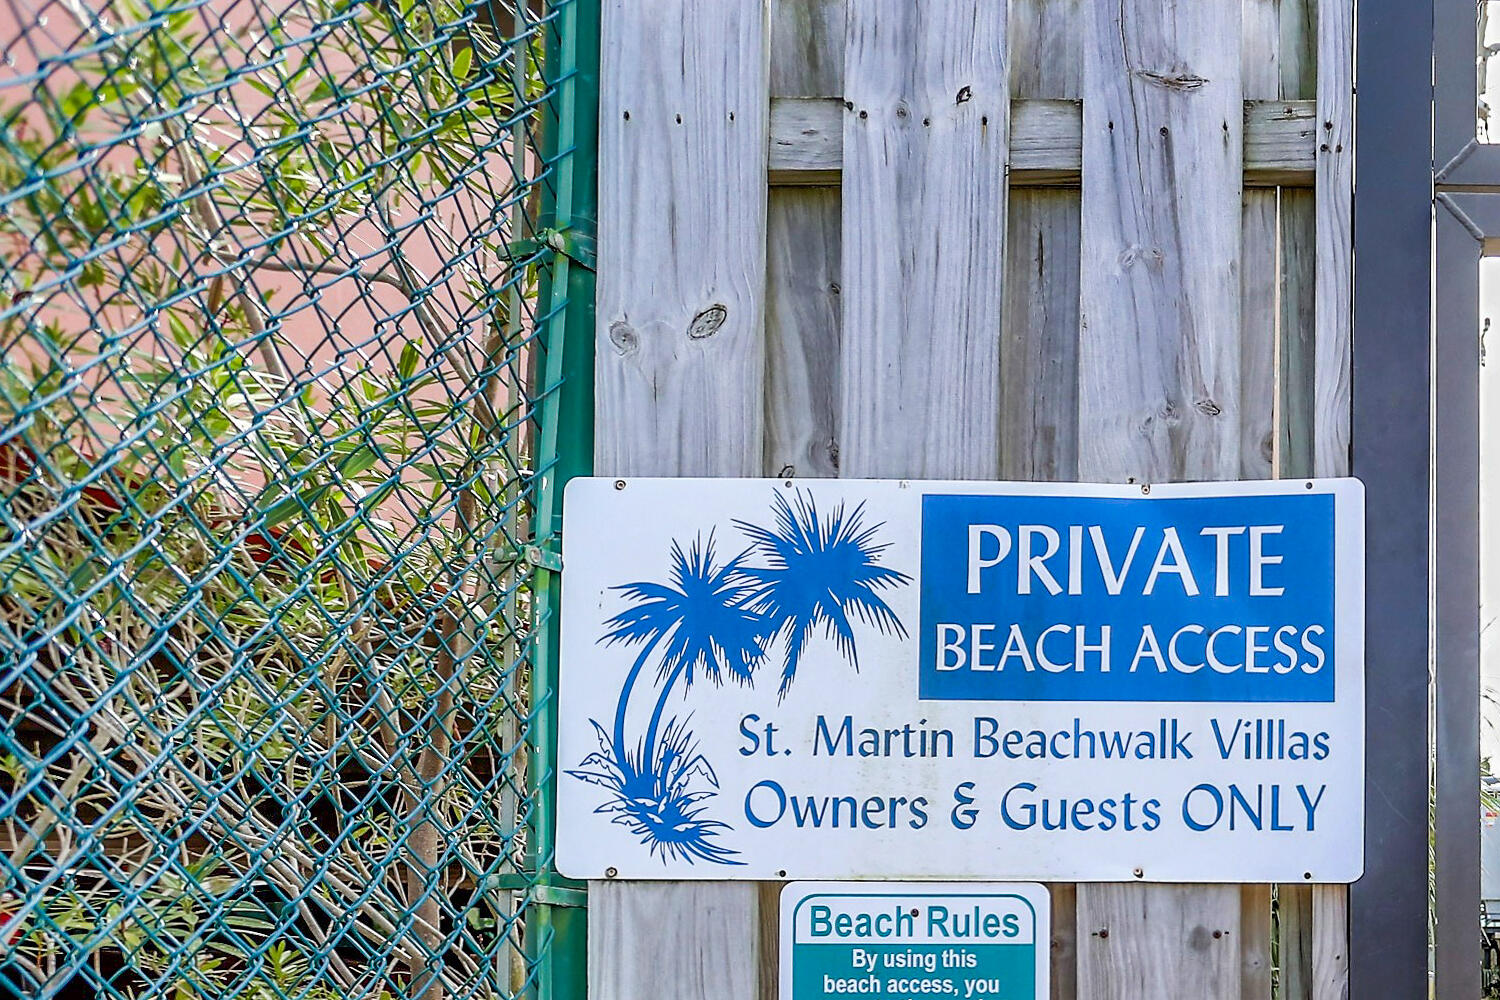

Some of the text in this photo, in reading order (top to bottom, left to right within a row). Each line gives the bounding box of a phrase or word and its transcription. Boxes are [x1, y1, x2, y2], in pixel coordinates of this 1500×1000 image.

[967, 524, 1285, 597] PRIVATE
[936, 623, 1325, 674] BEACH ACCESS
[738, 713, 1330, 761] St. Martin Beachwalk Villlas
[744, 779, 1327, 832] Owners & Guests ONLY
[810, 905, 1020, 938] Beach Rules
[852, 948, 977, 973] By using this
[823, 974, 1000, 999] beach access, you
